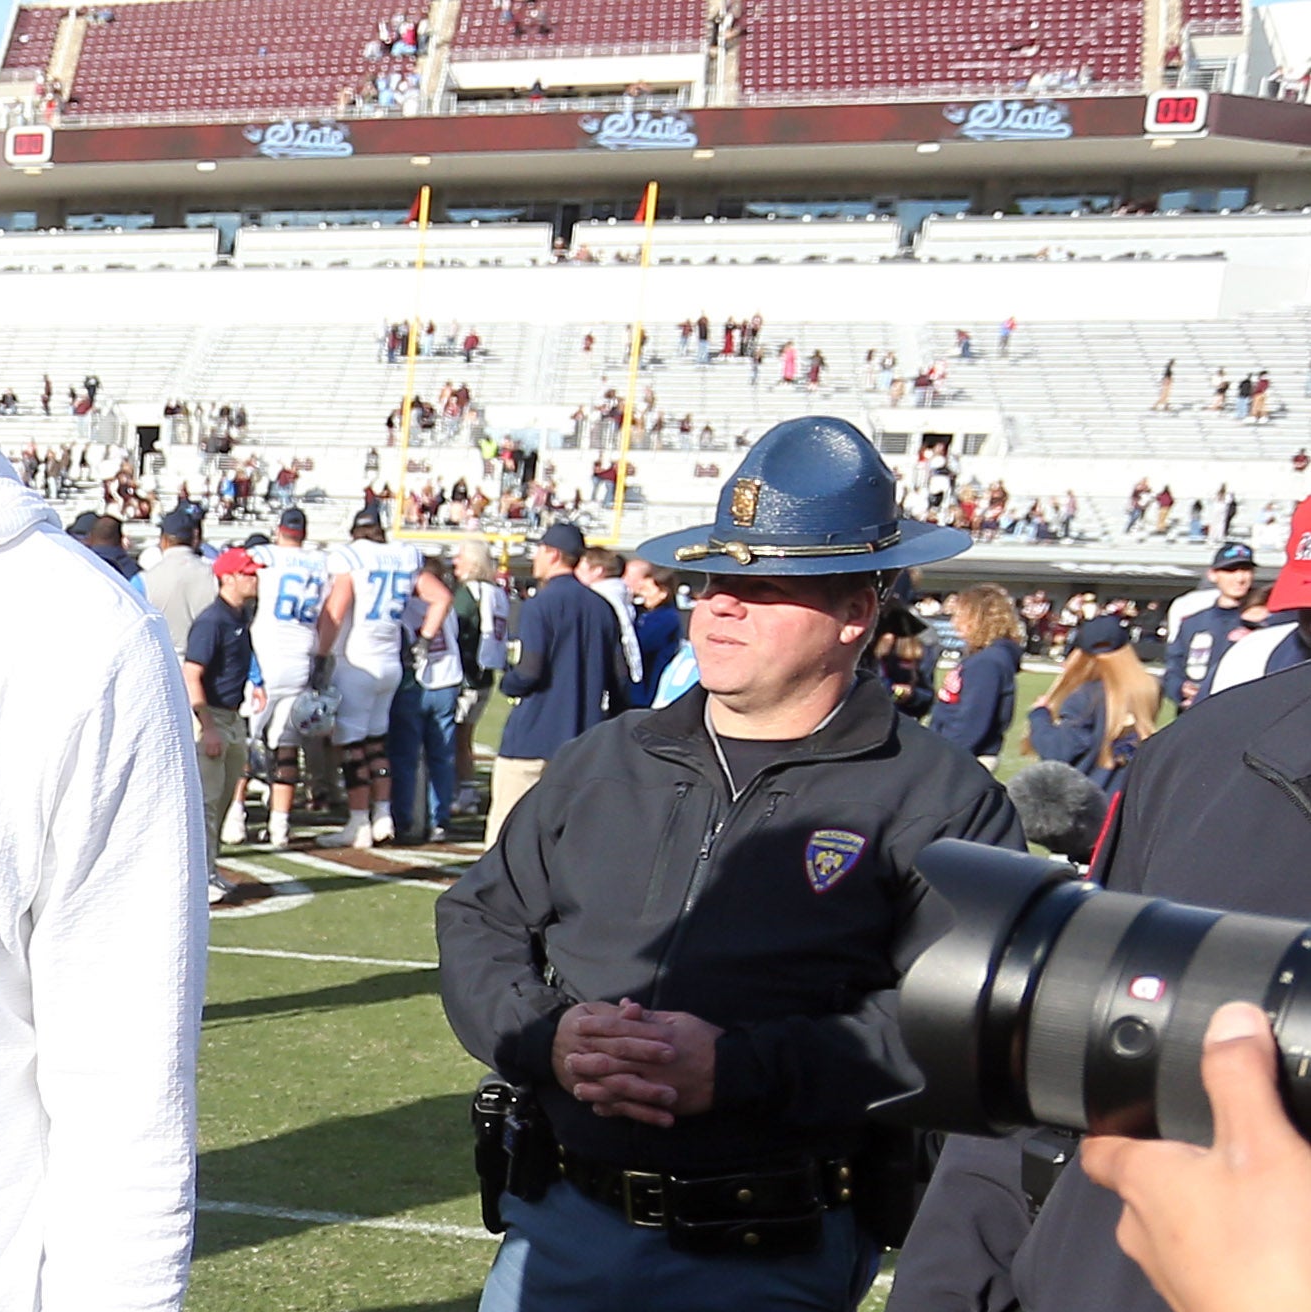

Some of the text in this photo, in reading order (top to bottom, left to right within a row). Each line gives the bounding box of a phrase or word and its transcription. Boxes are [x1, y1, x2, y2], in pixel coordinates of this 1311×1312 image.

[259, 118, 354, 158] State
[594, 110, 698, 150] State
[961, 100, 1074, 140] State
[274, 572, 323, 623] 62
[365, 570, 413, 620] 75
